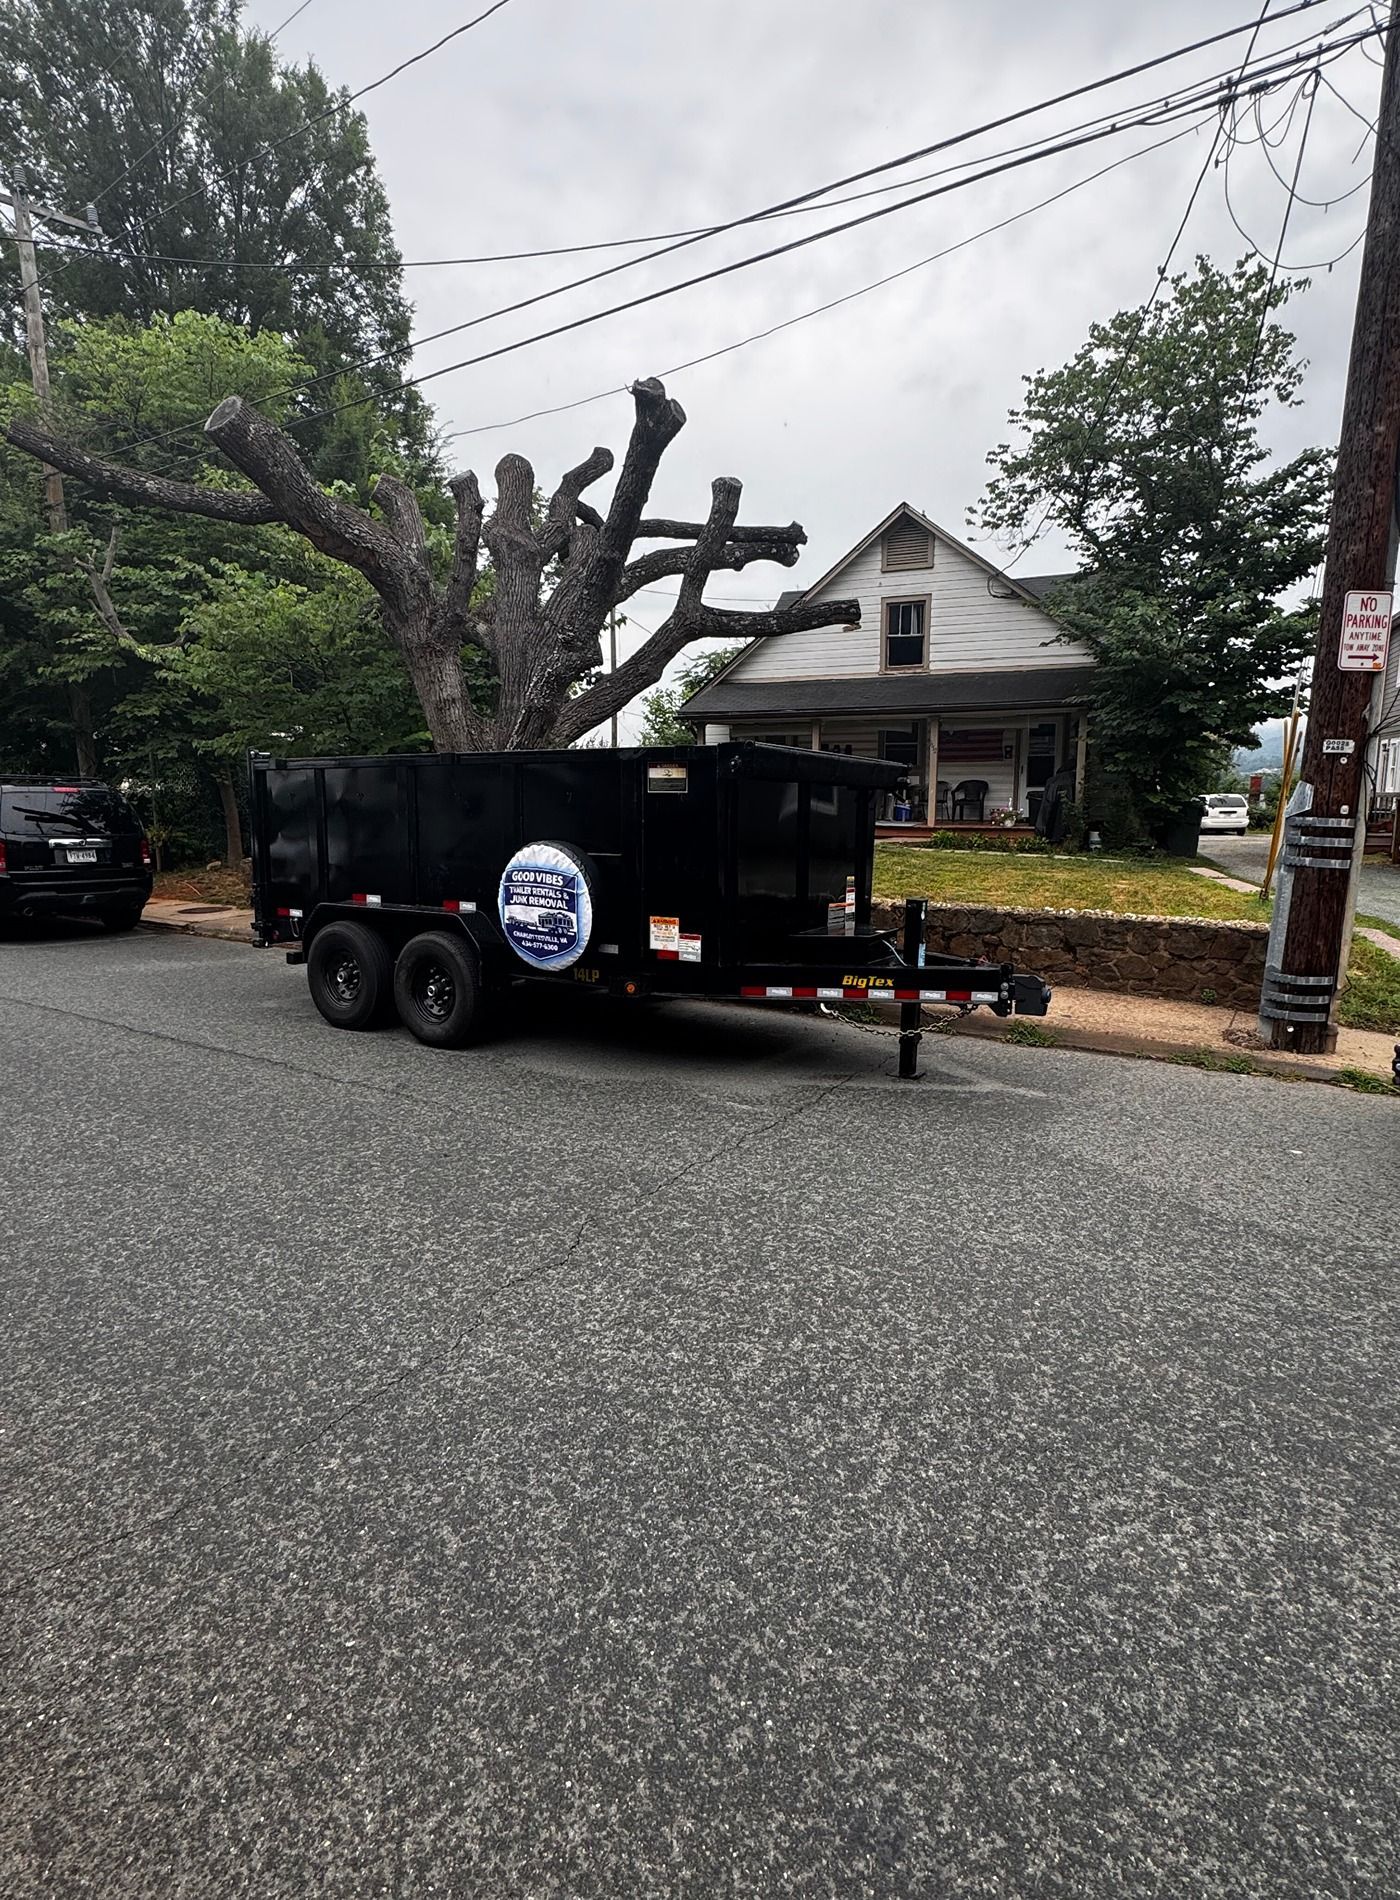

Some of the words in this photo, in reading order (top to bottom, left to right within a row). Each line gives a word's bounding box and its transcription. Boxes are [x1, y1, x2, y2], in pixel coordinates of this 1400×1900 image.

[1360, 597, 1377, 612] NO
[1346, 613, 1388, 629] PARKING
[1349, 631, 1382, 641] ANYTIME
[1344, 643, 1354, 651] TOW
[1357, 643, 1370, 652] AWAY
[1372, 643, 1385, 652] ZONE
[512, 871, 535, 882] GOOD
[535, 873, 564, 886] VIBES
[509, 886, 532, 895] TRAILER
[532, 888, 563, 899] RENTALS
[563, 892, 569, 900] &
[510, 895, 528, 904] JUNK
[528, 897, 568, 909] REMOVAL
[573, 967, 600, 983] 14LP
[842, 975, 895, 988] BigTex
